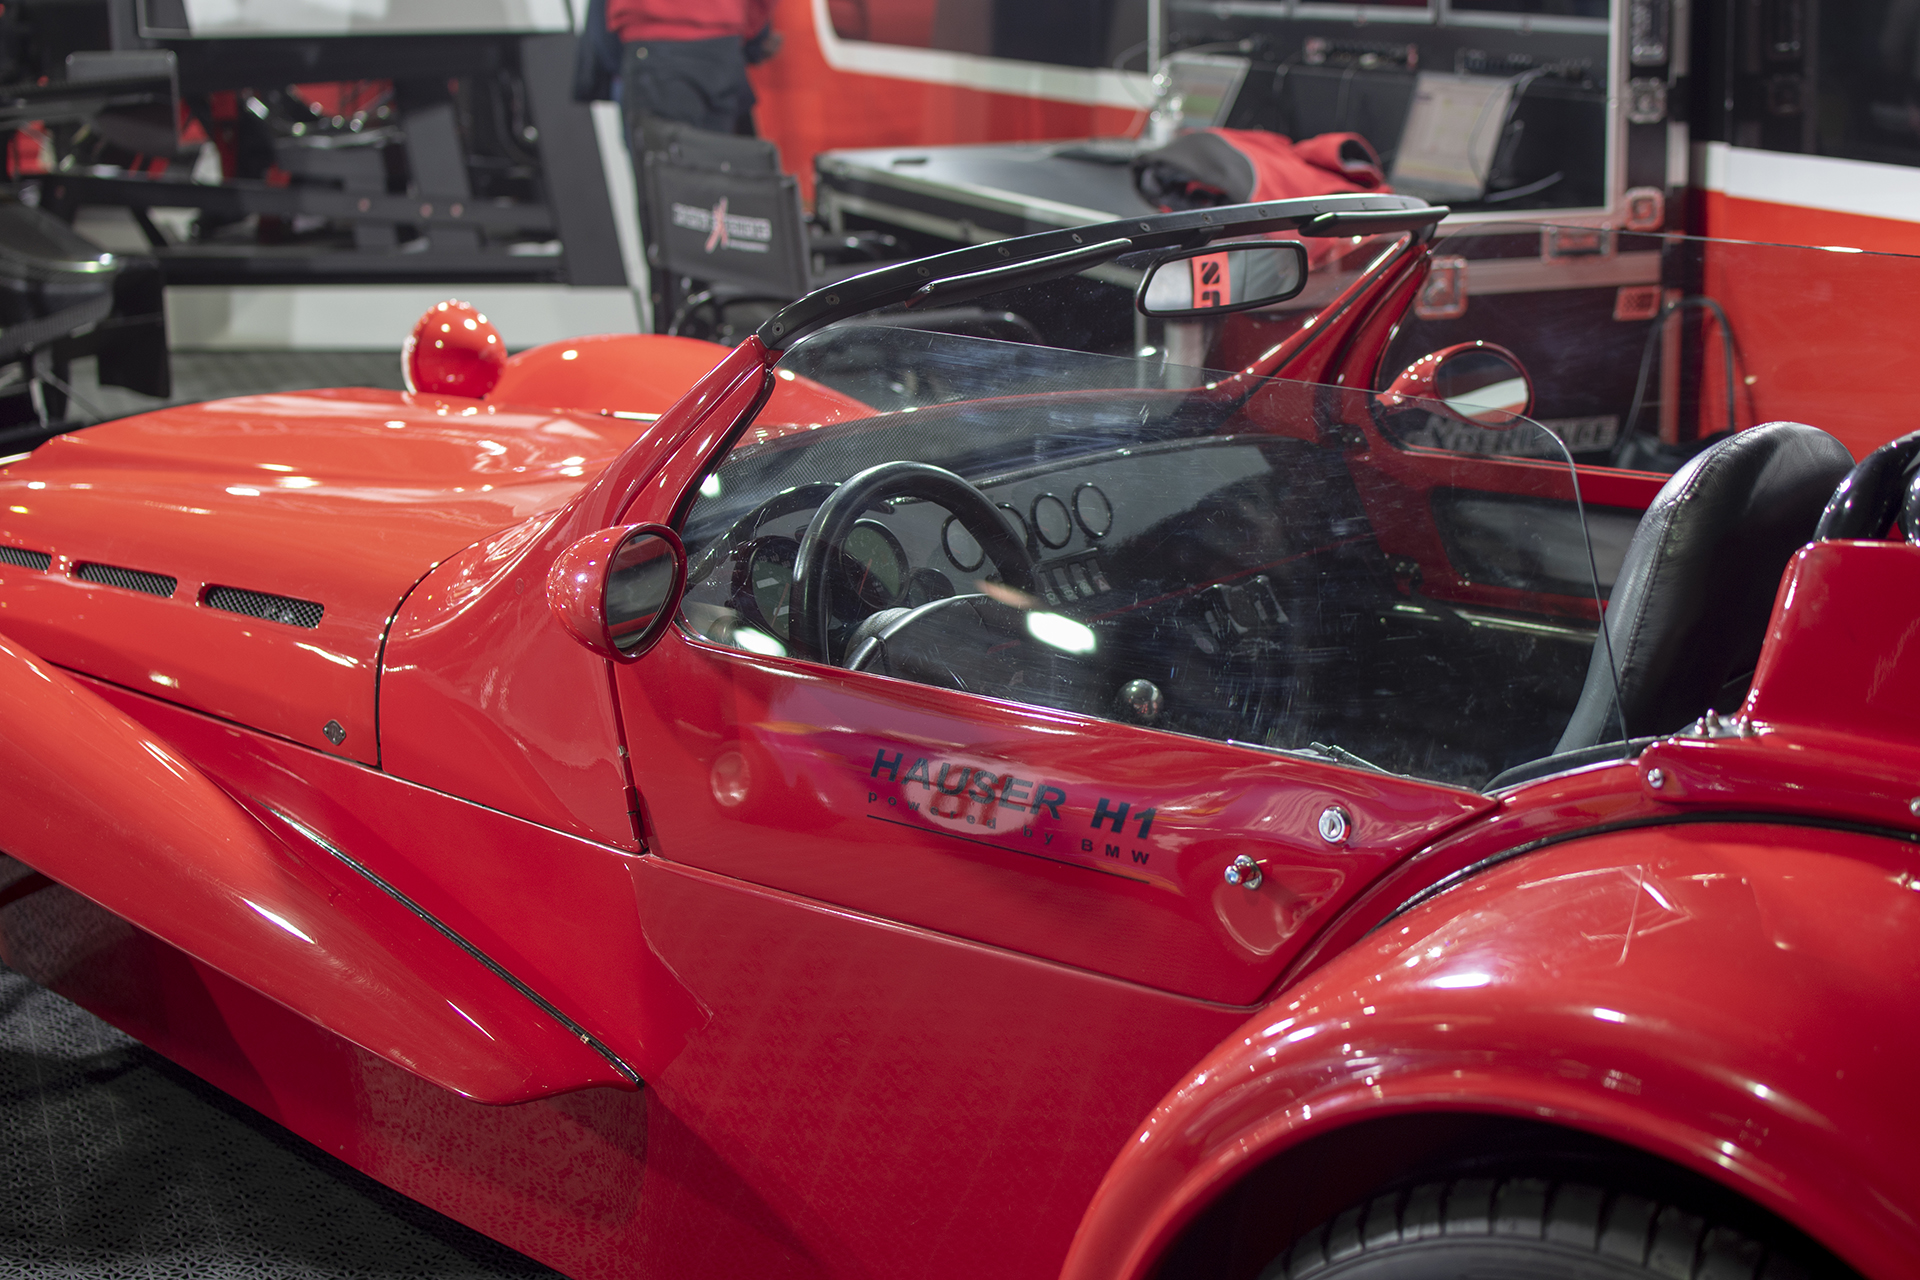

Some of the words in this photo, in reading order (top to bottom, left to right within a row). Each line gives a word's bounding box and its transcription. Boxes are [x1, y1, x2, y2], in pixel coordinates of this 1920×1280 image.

[868, 790, 996, 830] powered
[1022, 825, 1054, 845] by
[1081, 838, 1150, 865] BMW
[870, 748, 1066, 820] HAUSER
[1089, 797, 1157, 840] H1
